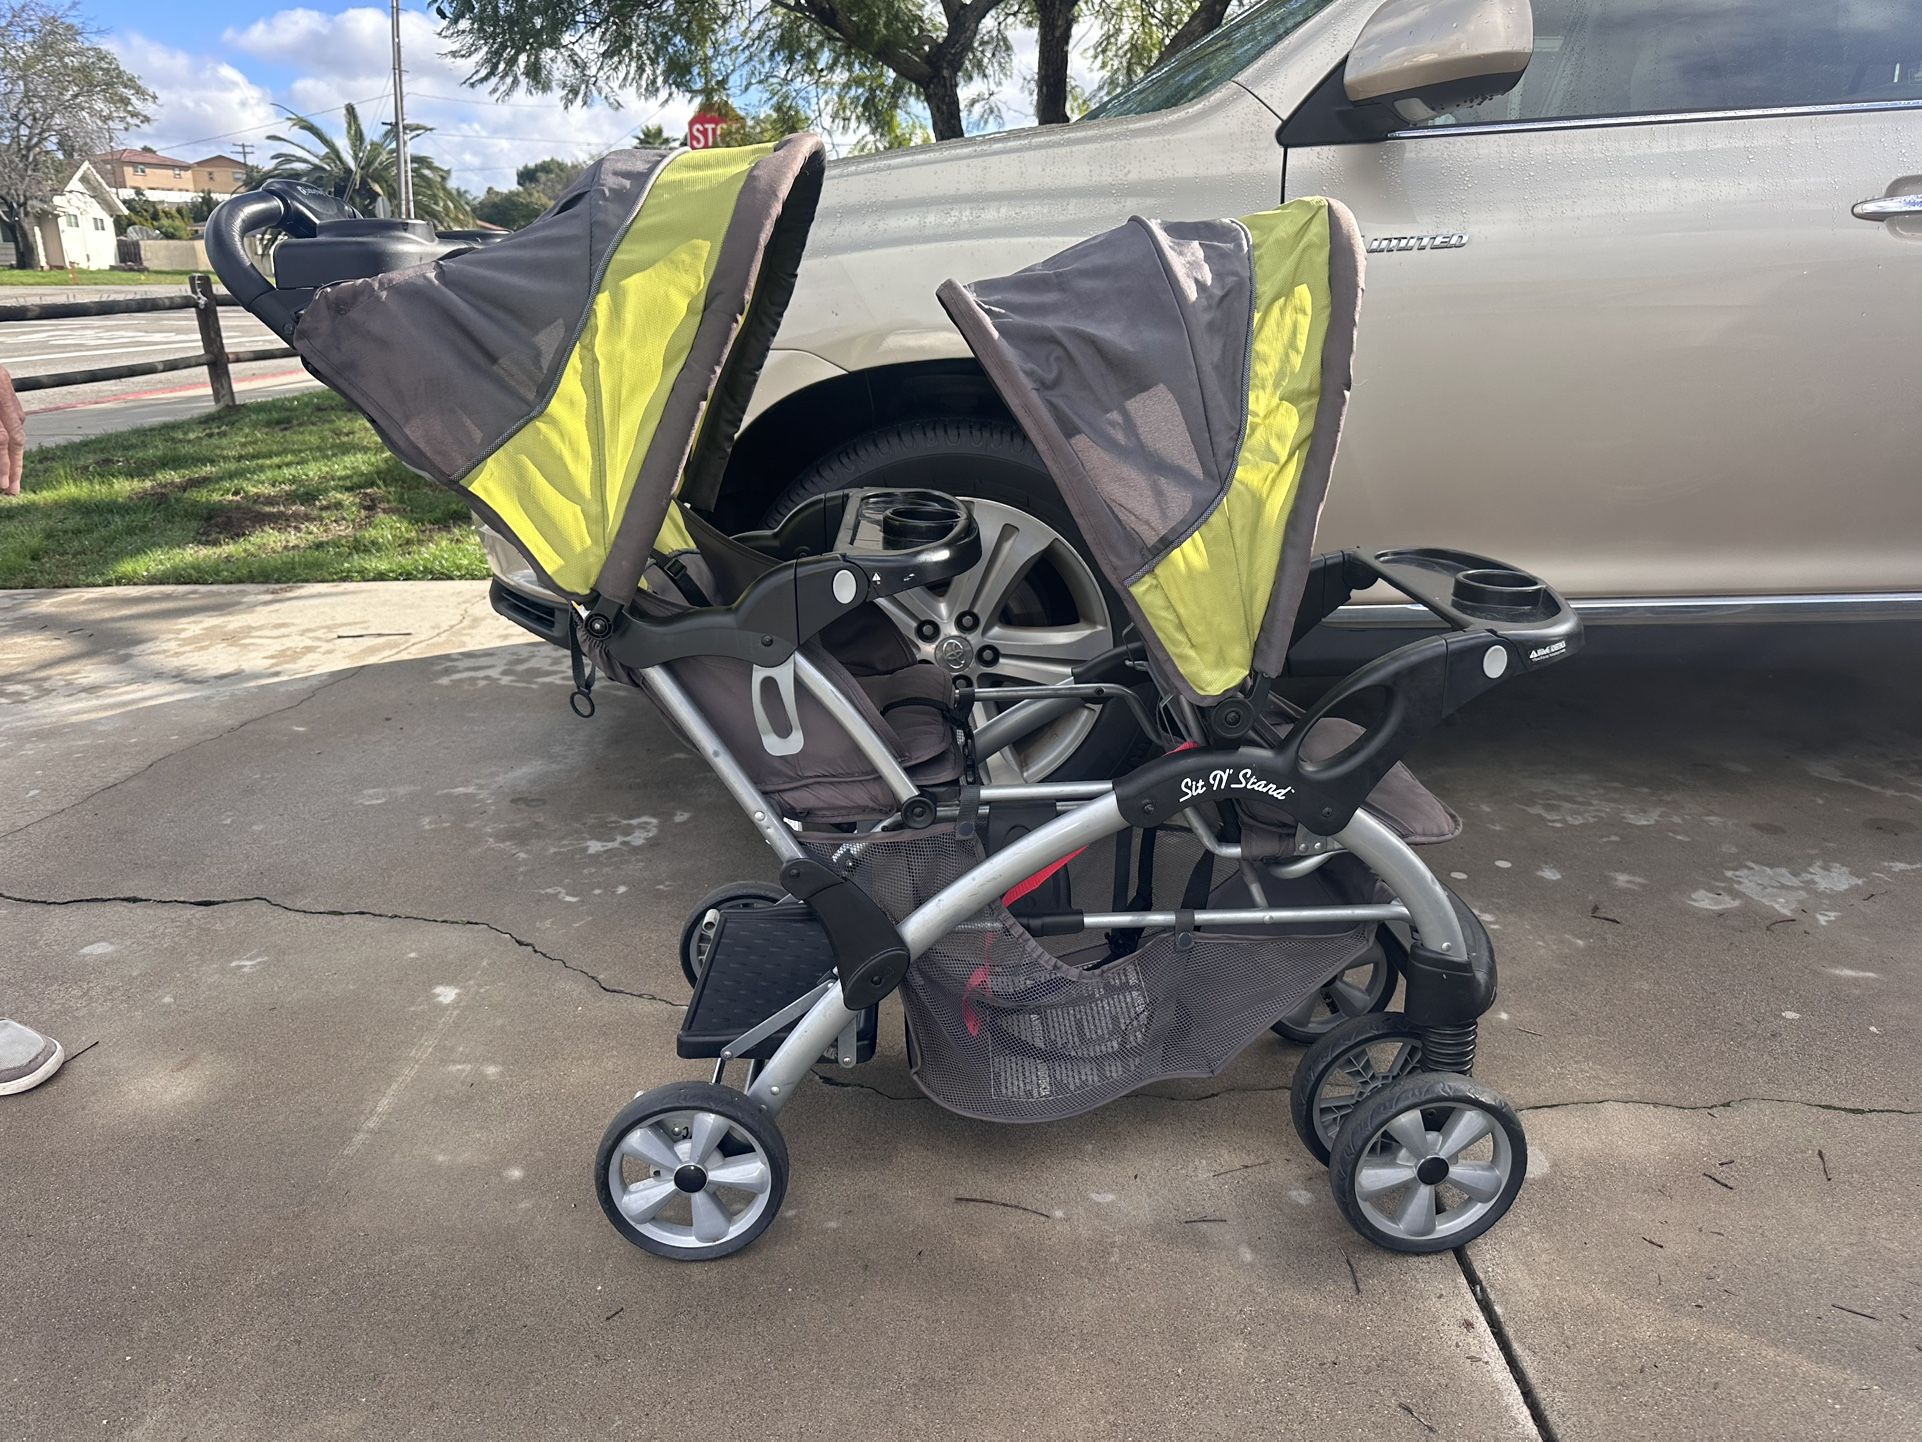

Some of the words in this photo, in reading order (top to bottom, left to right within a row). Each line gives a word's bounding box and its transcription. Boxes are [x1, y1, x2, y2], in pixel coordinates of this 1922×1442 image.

[1361, 233, 1469, 253] IMITED
[1179, 778, 1206, 802] Sit
[1230, 768, 1292, 800] Stand
